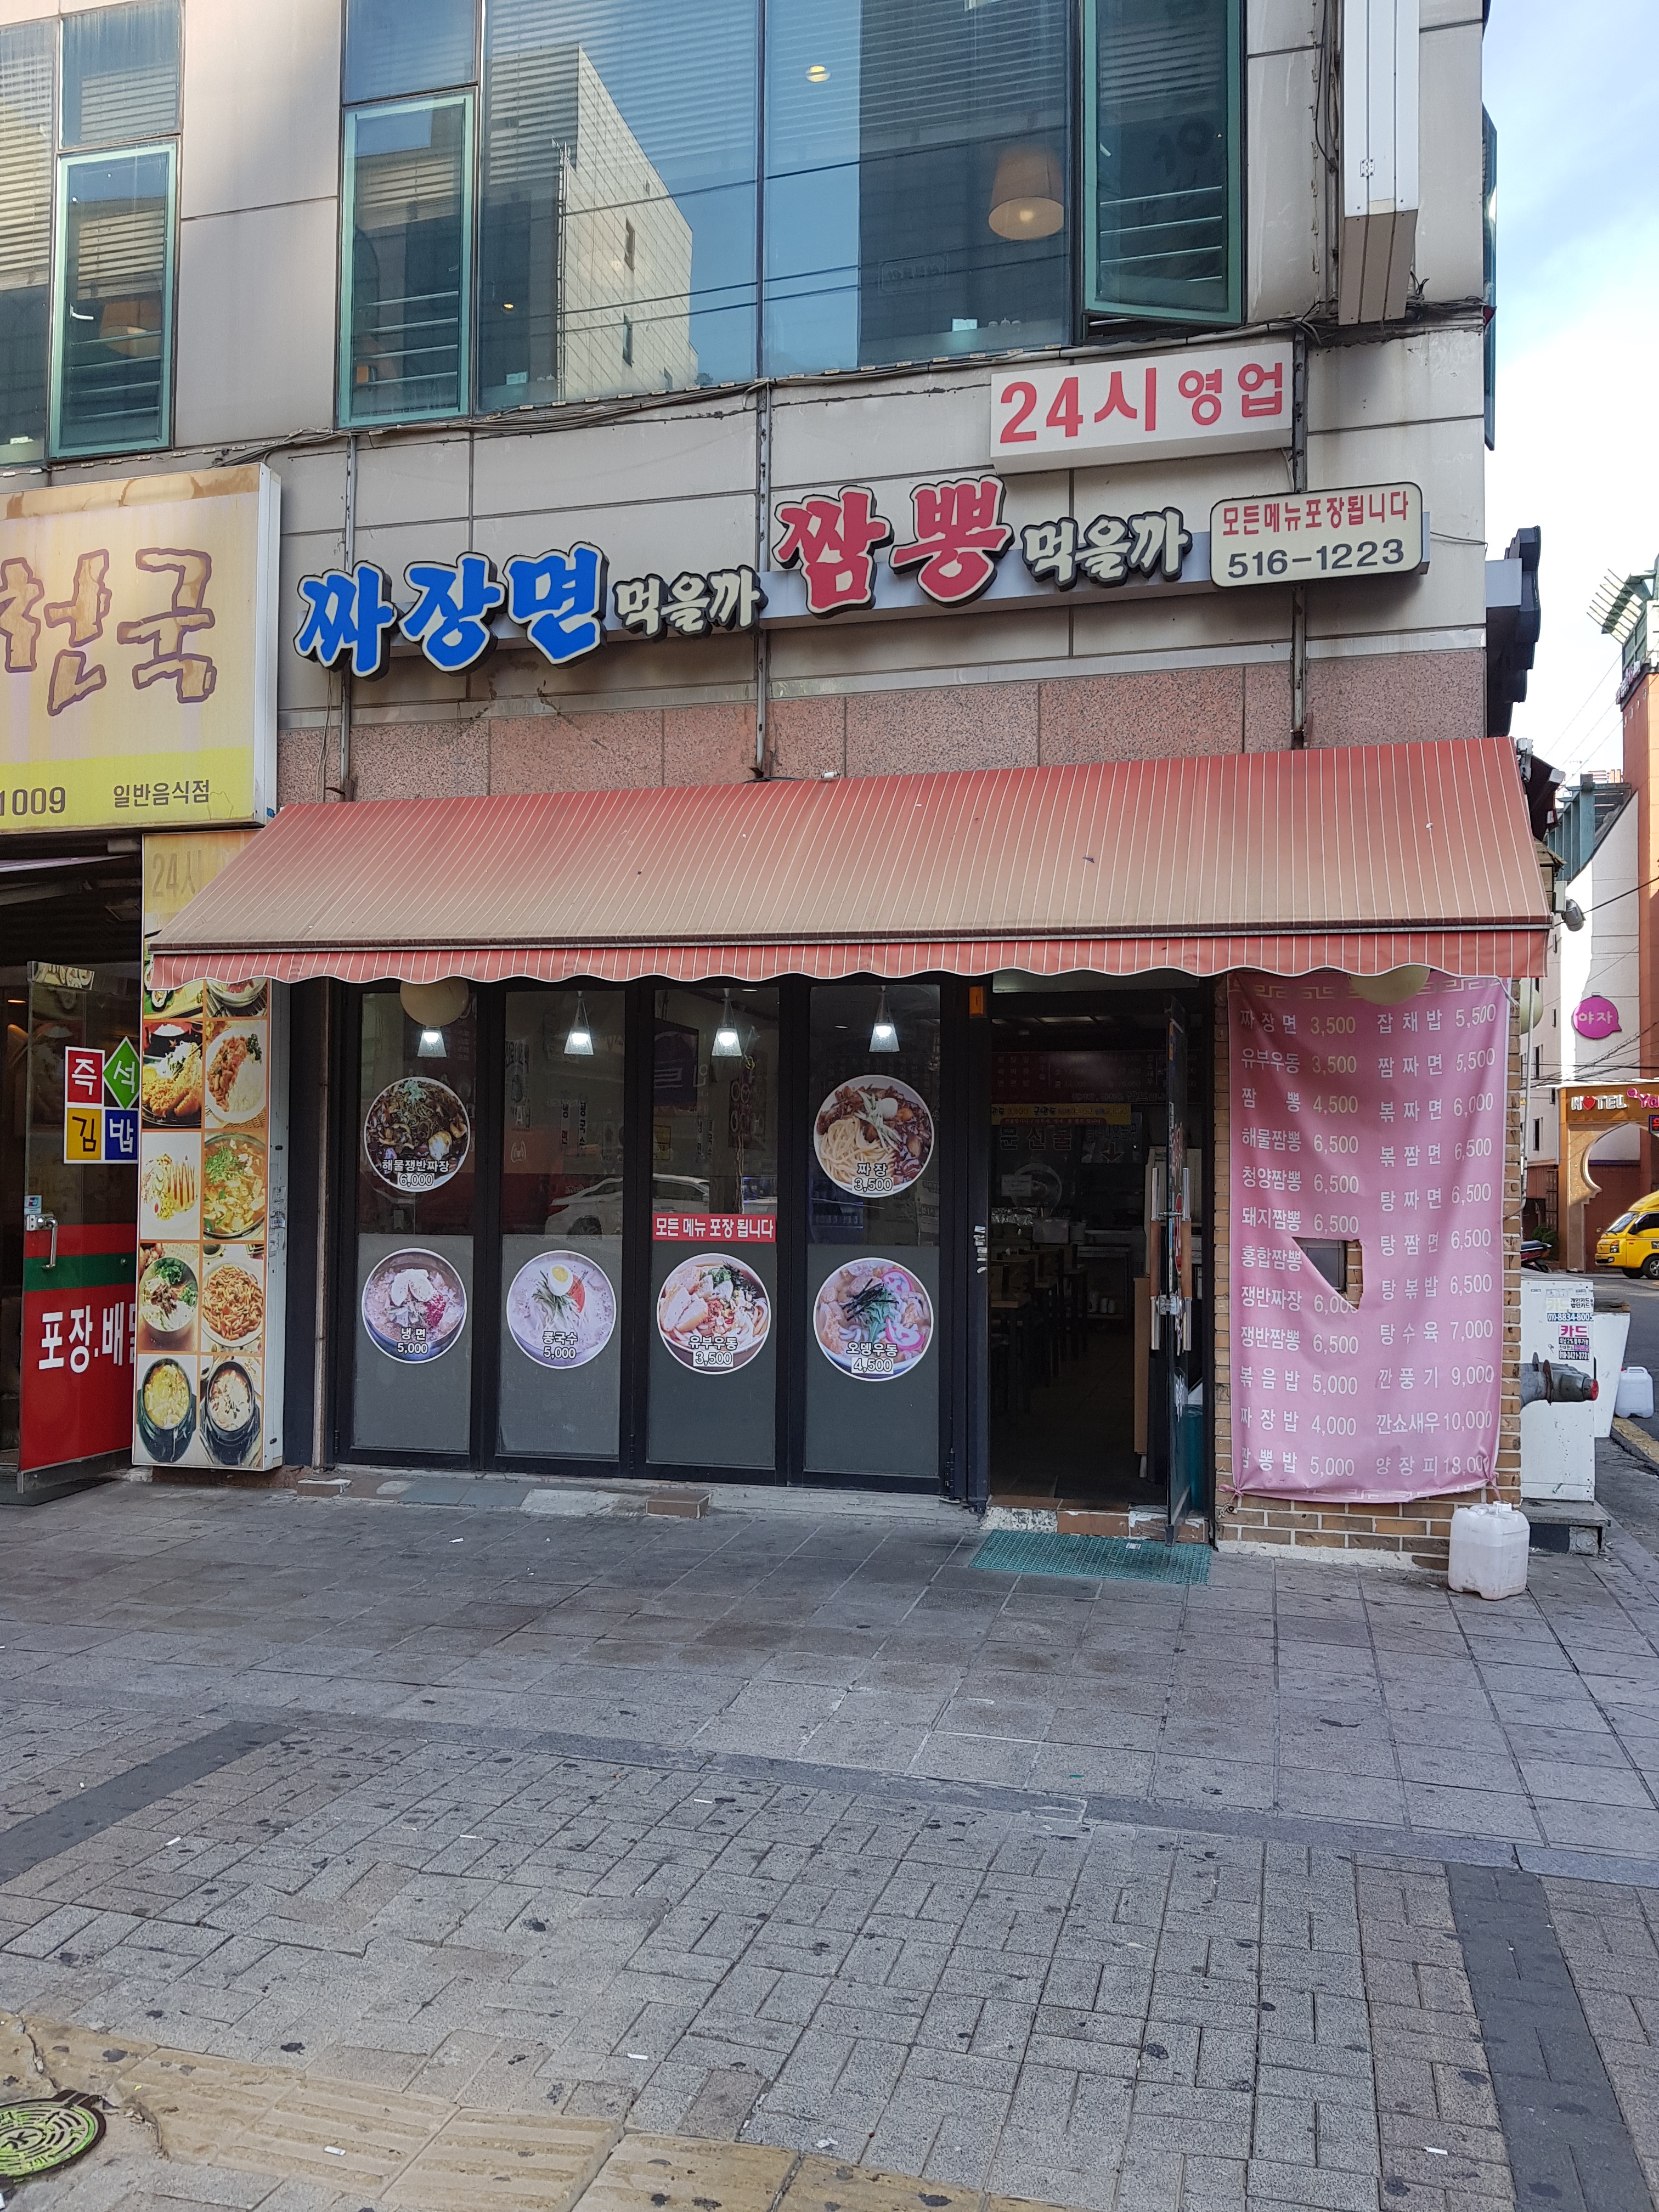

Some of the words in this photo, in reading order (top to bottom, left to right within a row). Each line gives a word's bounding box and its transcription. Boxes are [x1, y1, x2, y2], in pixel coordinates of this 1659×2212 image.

[1228, 539, 1404, 578] 516-1223
[295, 542, 604, 677] 짜장면
[615, 567, 764, 636] 먹을까
[774, 476, 1013, 616] 짬뽕
[1022, 509, 1191, 589] 먹을까
[114, 780, 210, 808] 일반음식점
[1310, 1017, 1356, 1036] 3,500
[1455, 1004, 1496, 1028] 5,500
[1578, 1011, 1613, 1024] 야자
[1242, 1048, 1300, 1074] 유부우동
[1312, 1056, 1357, 1075] 3,500
[1456, 1048, 1496, 1073] 5,500
[1313, 1096, 1358, 1115] 4,500
[1453, 1092, 1493, 1116] 6,000
[1242, 1127, 1301, 1152] 해물짬뽕
[1313, 1134, 1359, 1155] 6,500
[1454, 1138, 1492, 1160] 6,500
[382, 1159, 450, 1173] 해물쟁반짜장
[399, 1173, 433, 1187] 6,000
[854, 1177, 893, 1193] 3,500
[1242, 1166, 1301, 1191] 청양짬뽕
[1314, 1174, 1359, 1195] 6,500
[1452, 1183, 1492, 1206] 6,500
[656, 1218, 679, 1237] 모든
[682, 1219, 706, 1237] 메뉴
[710, 1219, 733, 1237] 포장
[737, 1218, 774, 1238] 됩니다
[1242, 1207, 1301, 1232] 돼지짬뽕
[1314, 1214, 1359, 1234] 6,500
[1451, 1229, 1492, 1251] 6,500
[1241, 1245, 1302, 1272] 홍합짬뽕
[1450, 1274, 1492, 1297] 6,500
[1241, 1286, 1302, 1311] 쟁반짜장
[1314, 1295, 1358, 1314] 6,00
[543, 1331, 578, 1345] 콩국수
[1240, 1326, 1301, 1351] 쟁반짬뽕
[1313, 1334, 1359, 1355] 6,500
[1450, 1319, 1493, 1342] 7,000
[1560, 1325, 1587, 1337] 카드
[397, 1342, 428, 1356] 5,000
[544, 1346, 576, 1360] 5,000
[689, 1336, 737, 1350] 유부우동
[847, 1342, 898, 1357] 오뎅우동
[695, 1351, 732, 1366] 3,500
[854, 1358, 893, 1373] 4,500
[1312, 1374, 1358, 1396] 5,000
[1451, 1365, 1494, 1387] 9,000
[1311, 1415, 1356, 1436] 4,000
[1376, 1412, 1440, 1434] 깐쇼새우
[1443, 1410, 1492, 1432] 10,000
[1310, 1456, 1355, 1477] 5,000
